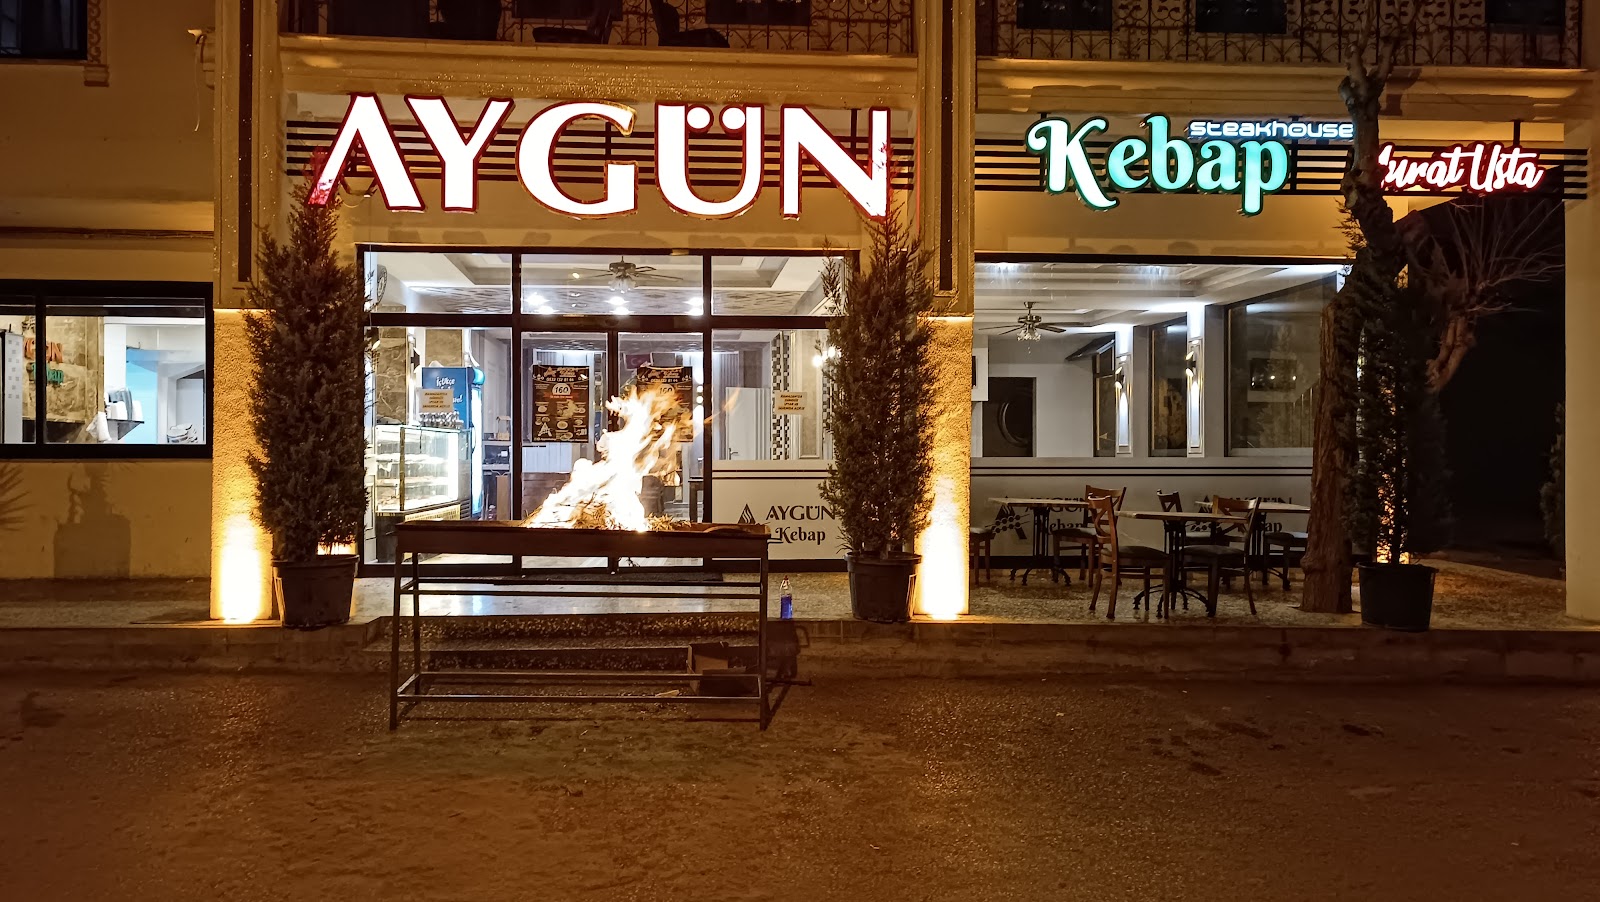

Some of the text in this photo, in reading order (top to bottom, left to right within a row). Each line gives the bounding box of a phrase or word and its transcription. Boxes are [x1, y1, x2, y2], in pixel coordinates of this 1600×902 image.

[304, 92, 892, 220] AYGÜN
[1026, 113, 1292, 216] Kebap
[1468, 141, 1545, 193] Usta
[766, 505, 835, 520] AYGÜN
[775, 526, 825, 544] Kebap
